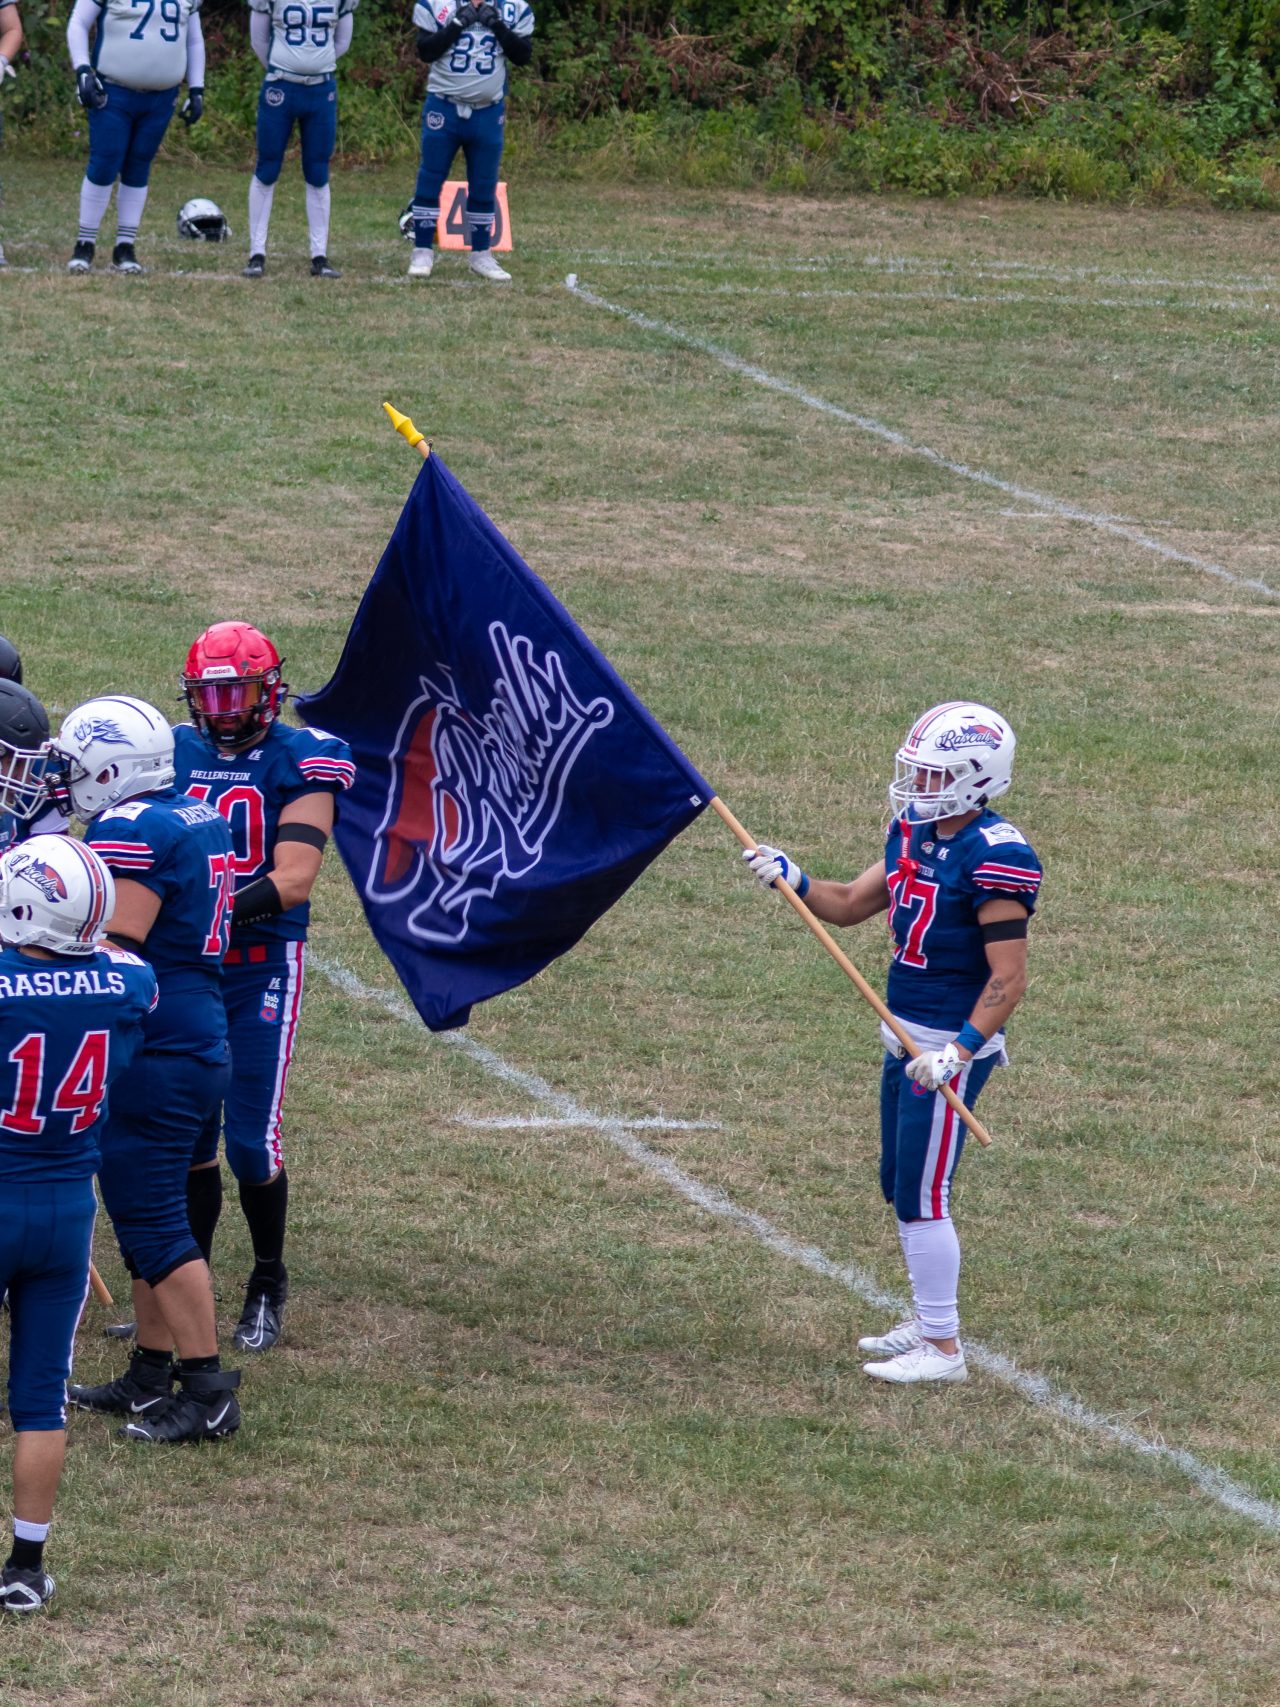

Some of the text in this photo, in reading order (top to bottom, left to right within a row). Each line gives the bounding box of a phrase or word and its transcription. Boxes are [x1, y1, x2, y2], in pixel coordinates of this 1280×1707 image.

[129, 0, 181, 42] 79
[283, 5, 334, 47] 85
[503, 3, 516, 22] C
[450, 33, 498, 75] 83
[934, 729, 997, 751] Rascals
[189, 769, 251, 781] HELLENSTEIN
[184, 783, 266, 876] 0
[264, 992, 279, 1004] hsb
